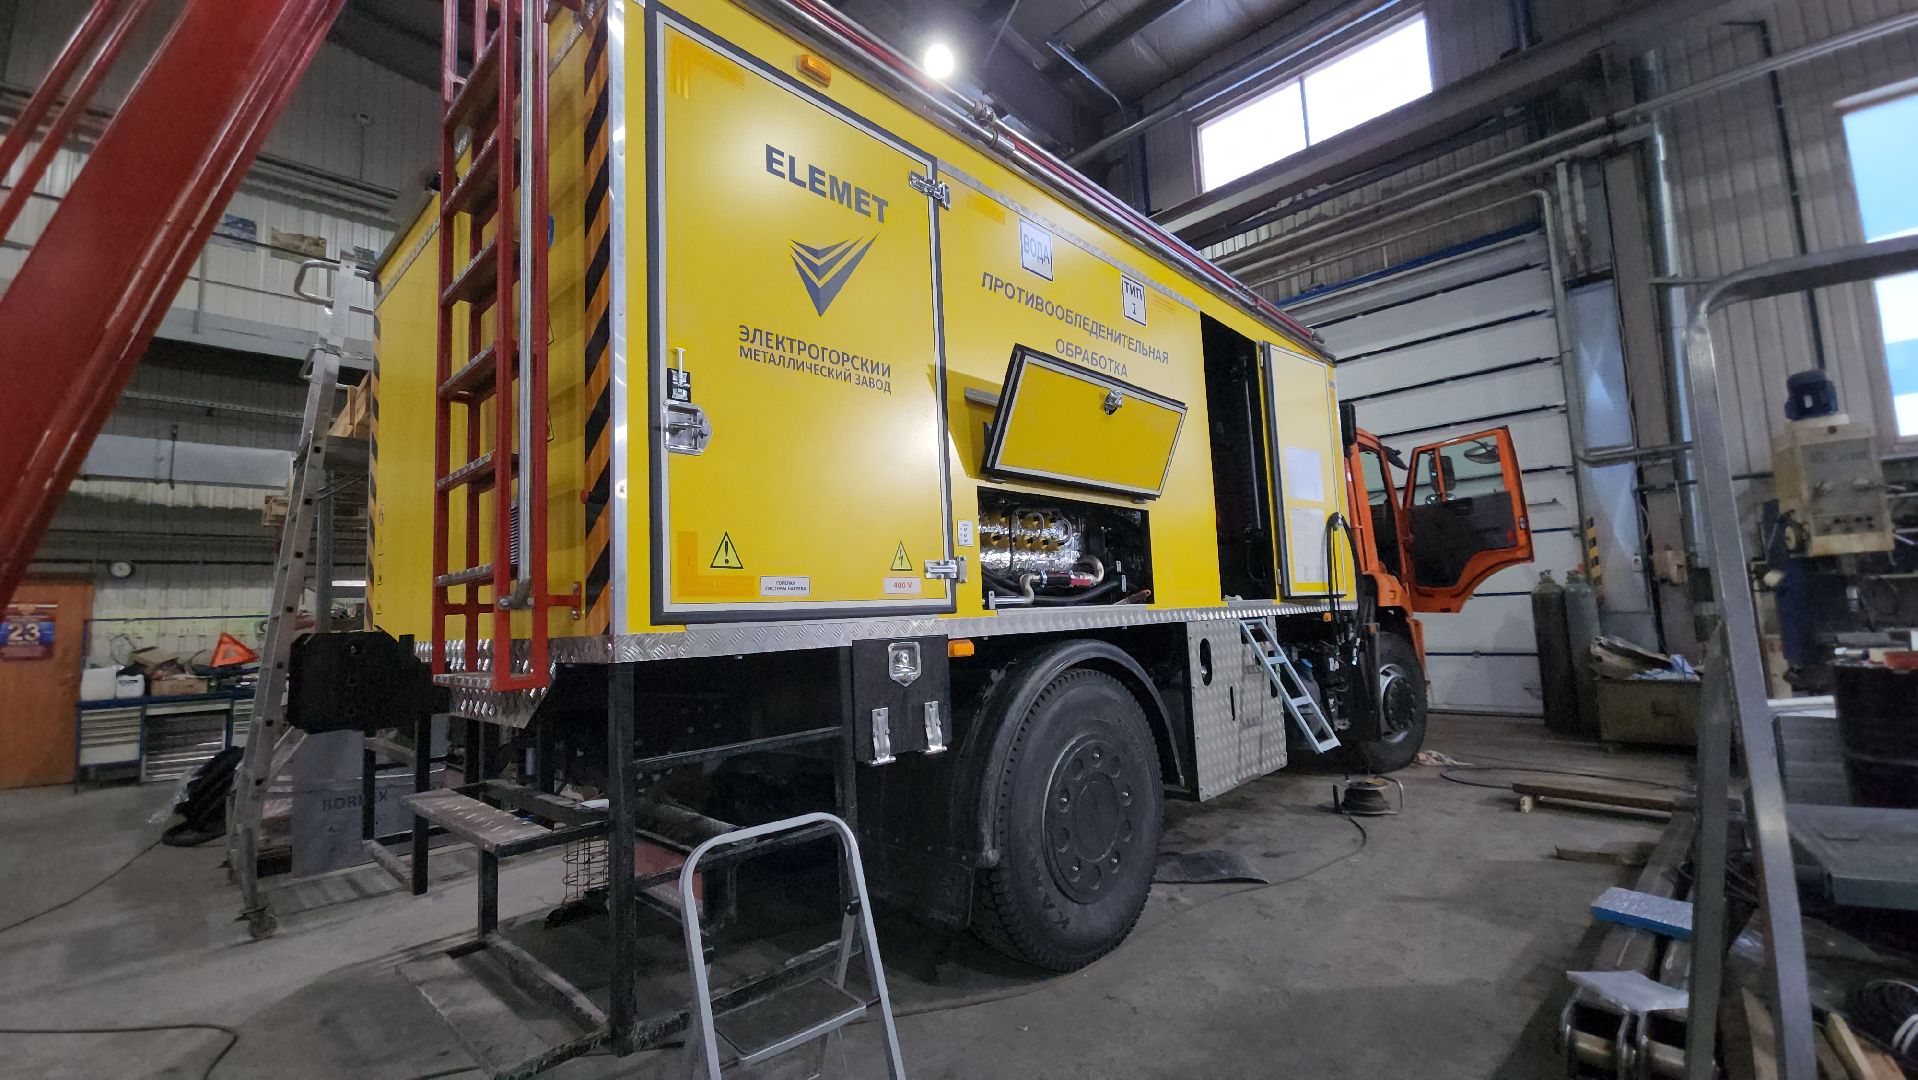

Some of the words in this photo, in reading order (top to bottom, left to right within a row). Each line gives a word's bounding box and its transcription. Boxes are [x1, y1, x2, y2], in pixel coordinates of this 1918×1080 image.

[765, 143, 889, 224] ELEMET
[1022, 232, 1051, 264] ВОДА
[1123, 280, 1142, 301] ТИП
[981, 271, 1169, 365] ПРОТИВООБЛЕДЕНИТЕЛЬНАЯ
[739, 346, 852, 383] МЕТАЛЛИЧЕСКИЙ
[854, 372, 892, 396] ЗАВОД
[1055, 338, 1128, 379] ОБРАБОТКА
[893, 581, 906, 589] 400
[907, 581, 913, 589] V
[8, 622, 41, 641] 23
